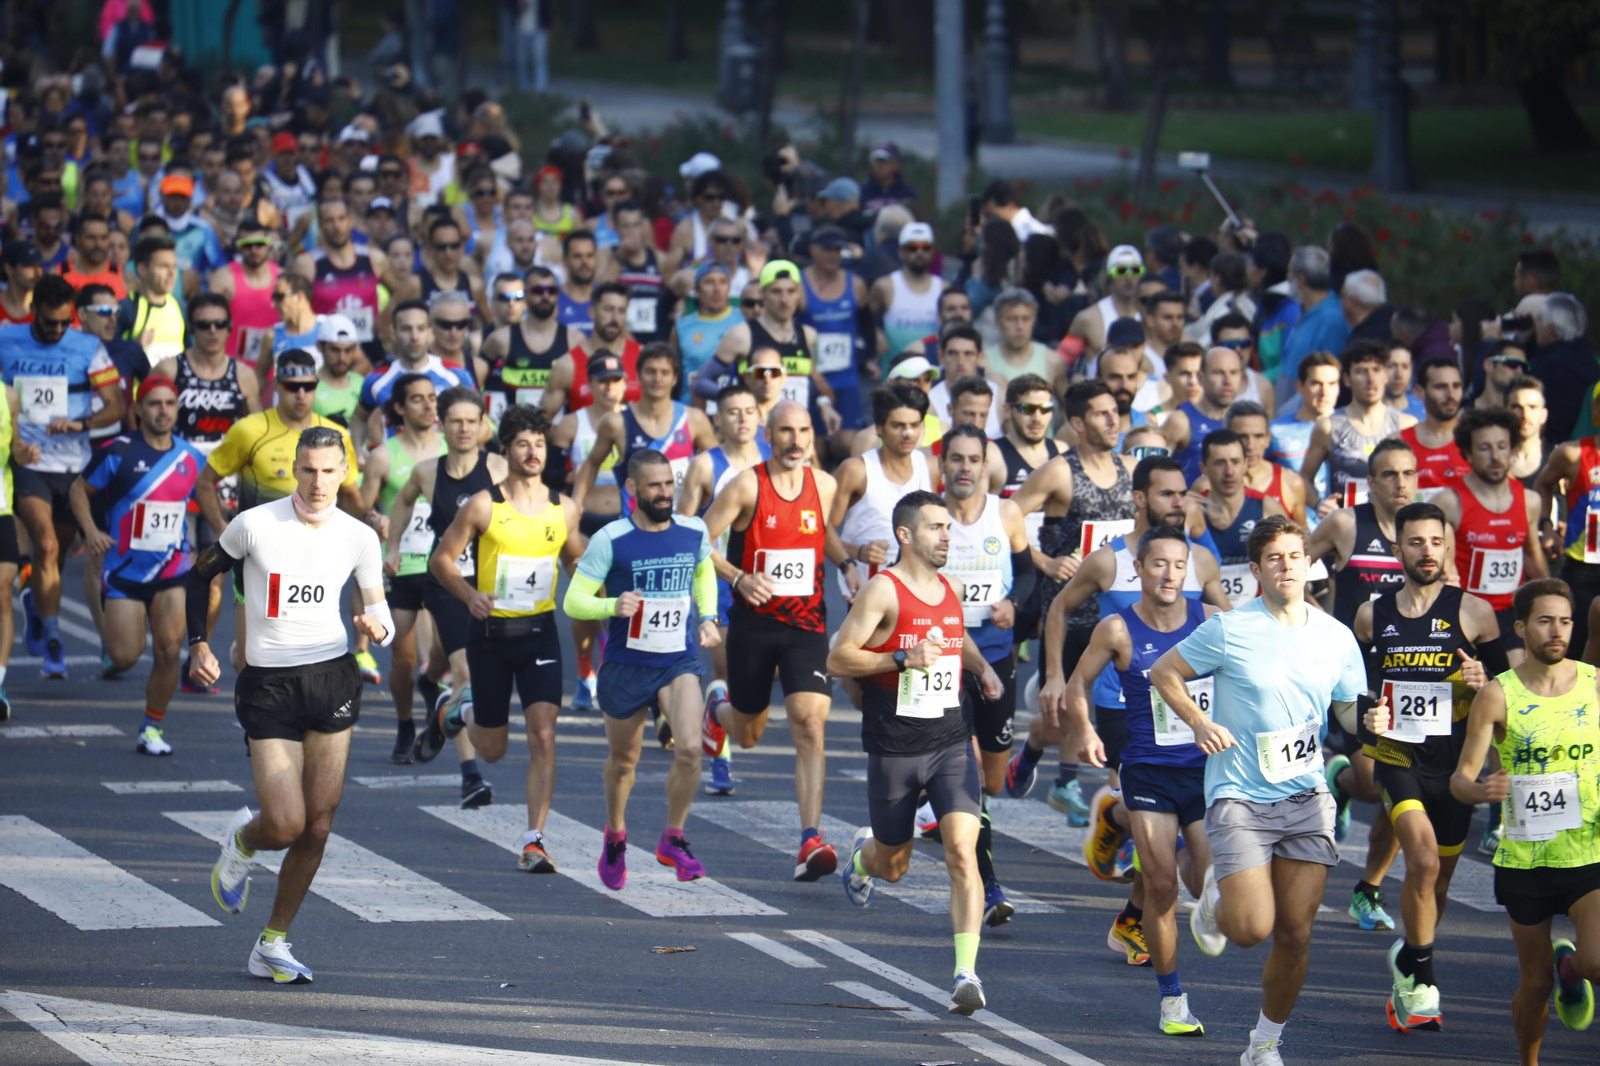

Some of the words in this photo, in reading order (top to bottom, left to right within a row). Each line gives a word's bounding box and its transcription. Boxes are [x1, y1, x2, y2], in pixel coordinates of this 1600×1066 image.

[34, 388, 54, 404] 20
[150, 512, 179, 529] 317
[643, 556, 696, 566] ANIVERSARIO
[1489, 561, 1518, 578] 333
[525, 570, 537, 588] 4
[771, 562, 805, 579] 463
[287, 584, 325, 604] 260
[649, 610, 681, 628] 413
[1386, 646, 1404, 654] CLUB
[1404, 645, 1442, 653] DEPORTIVO
[1382, 652, 1454, 669] ARUNCI
[921, 671, 952, 691] 132
[1400, 695, 1438, 717] 281
[1281, 734, 1316, 762] 124
[1525, 788, 1566, 813] 434
